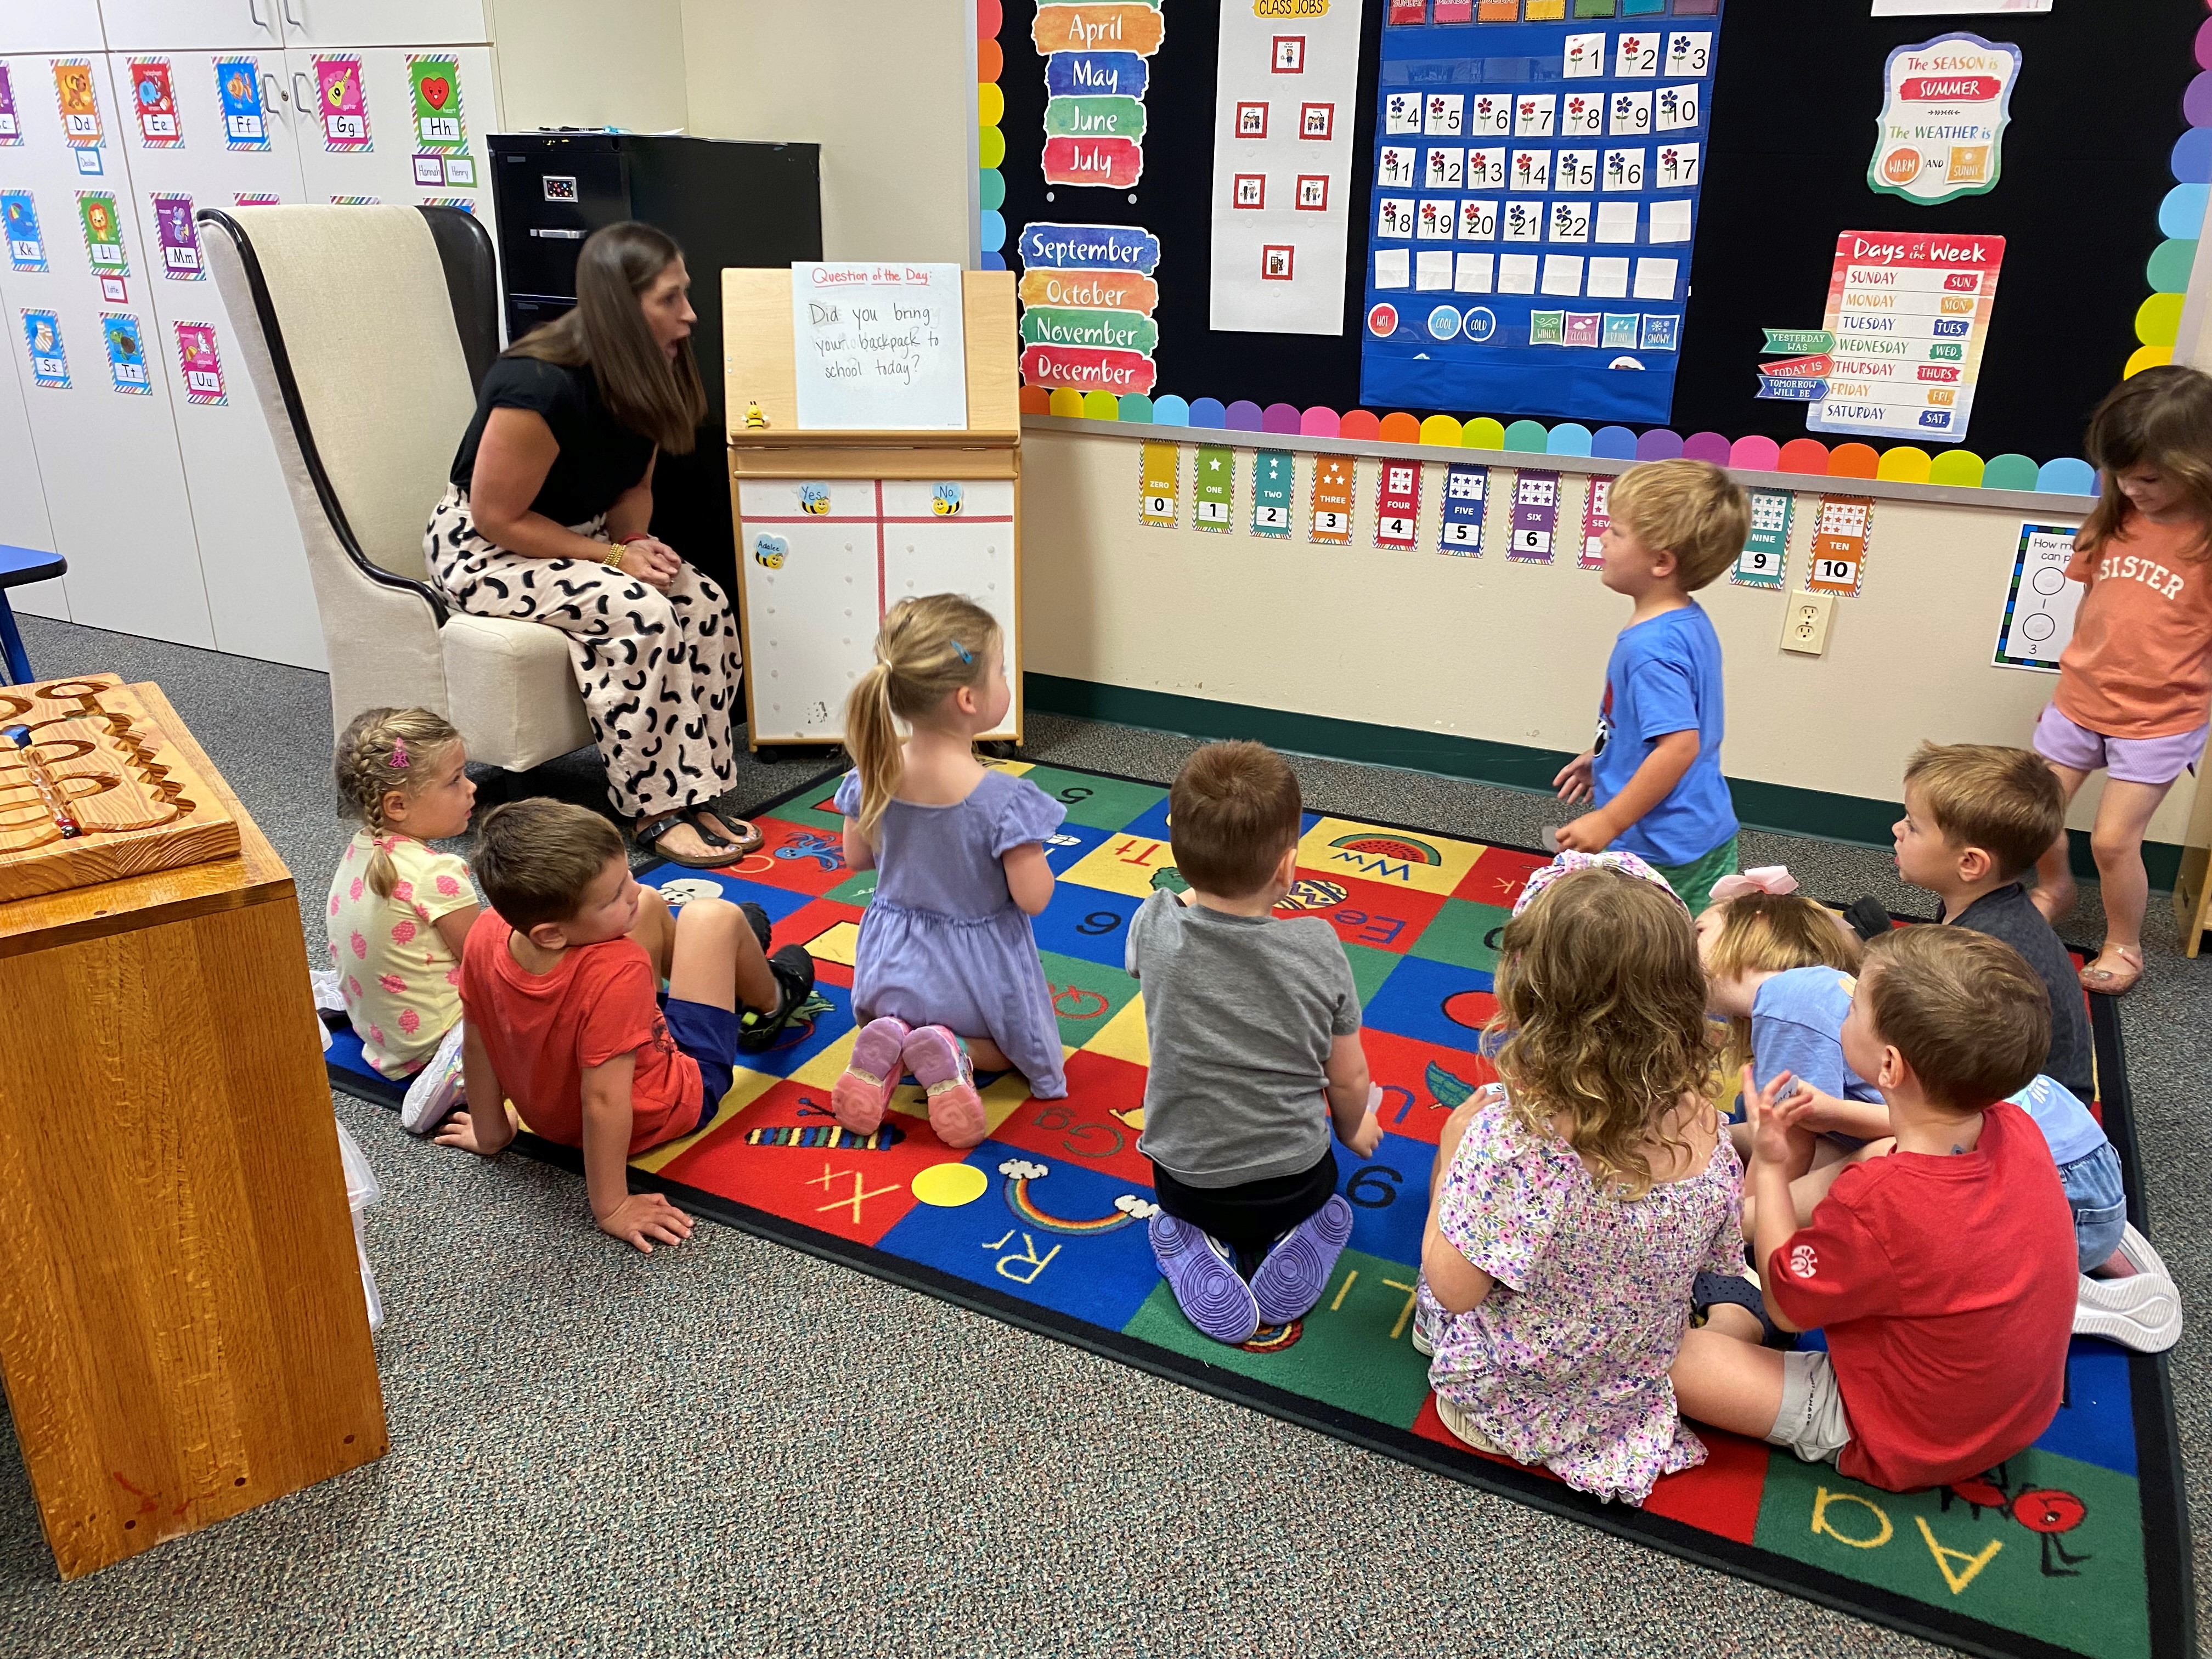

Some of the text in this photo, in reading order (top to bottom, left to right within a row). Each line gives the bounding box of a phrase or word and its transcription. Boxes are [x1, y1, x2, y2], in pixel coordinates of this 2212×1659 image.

[1259, 0, 1323, 15] CLASS JOBS
[1069, 14, 1122, 49] April
[1590, 48, 1706, 70] 1 2 3
[1908, 57, 1998, 71] The SEASON is
[1073, 60, 1118, 94] May
[1920, 80, 1980, 98] SUMMER
[1070, 106, 1118, 132] June
[1407, 100, 1695, 129] 4 5 6 7 8 9 10
[74, 115, 90, 131] Dd
[151, 115, 168, 131] Ee
[236, 116, 251, 133] Ff
[337, 116, 354, 137] Gg
[430, 117, 451, 136] Hh
[1889, 126, 1991, 139] The WEATHER is
[1070, 145, 1111, 178] July
[1889, 159, 1916, 174] WARM
[1925, 159, 1944, 168] AND
[419, 165, 441, 177] Hannah
[452, 166, 469, 180] Henry
[1392, 159, 1696, 185] 11 12 13 14 15 16 17
[1954, 165, 1979, 177] SUNNY
[1389, 213, 1587, 236] 18 19 20 21 22
[19, 242, 34, 256] Kk
[173, 249, 193, 264] Mm
[1032, 233, 1144, 267] September
[1853, 238, 1986, 265] Days of the Week
[812, 267, 868, 283] Question
[872, 268, 883, 281] of
[884, 268, 901, 281] the
[1850, 270, 1974, 289] SUNDAY SUN.
[1046, 280, 1127, 306] October
[1846, 293, 1969, 312] MONDAY MON.
[809, 302, 930, 329] Did you bring
[1376, 315, 1389, 327] HOT
[1037, 317, 1138, 346] November
[1436, 318, 1452, 330] COOL
[1471, 319, 1487, 331] COLD
[1843, 315, 1965, 335] TUESDAY TUES.
[1537, 329, 1556, 339] WINDY
[1571, 331, 1593, 342] CLOUDY
[1610, 332, 1629, 342] RAINY
[1647, 333, 1671, 345] SNOWY
[1772, 333, 1826, 343] YESTERDAY
[816, 331, 939, 357] your backpack to
[1787, 342, 1808, 352] WAS
[1839, 338, 1959, 357] WEDNESDAY WED.
[43, 360, 57, 373] Ss
[122, 364, 135, 379] Tt
[825, 354, 919, 385] school today?
[1038, 354, 1135, 385] December
[1773, 360, 1822, 377] TODAY IS
[1835, 360, 1955, 380] THURSDAY THURS.
[196, 373, 212, 387] Uu
[1769, 379, 1817, 389] TOMORROW
[1774, 388, 1810, 398] WILL BE
[1830, 382, 1950, 403] FRIDAY FRI.
[1826, 404, 1946, 425] SATURDAY SAT.
[939, 486, 953, 498] No
[1149, 481, 1170, 489] ZERO
[1206, 486, 1223, 494] ONE
[801, 486, 821, 501] Yes
[1263, 490, 1282, 499] TWO
[1320, 495, 1346, 505] THREE
[1154, 498, 1164, 512] 0
[1209, 503, 1217, 517] 1
[1387, 501, 1410, 510] FOUR
[1454, 507, 1474, 515] FIVE
[1267, 508, 1277, 523] 2
[1326, 514, 1336, 528] 3
[1527, 513, 1542, 522] SIX
[1391, 520, 1403, 533] 4
[1457, 525, 1468, 540] 5
[1526, 532, 1538, 547] 6
[1752, 534, 1776, 543] NINE
[1830, 541, 1849, 551] TEN
[2034, 538, 2058, 550] How
[1754, 554, 1767, 569] 9
[2041, 552, 2061, 561] can
[1824, 561, 1848, 577] 10
[2098, 556, 2185, 600] SISTER
[2029, 644, 2037, 654] 3
